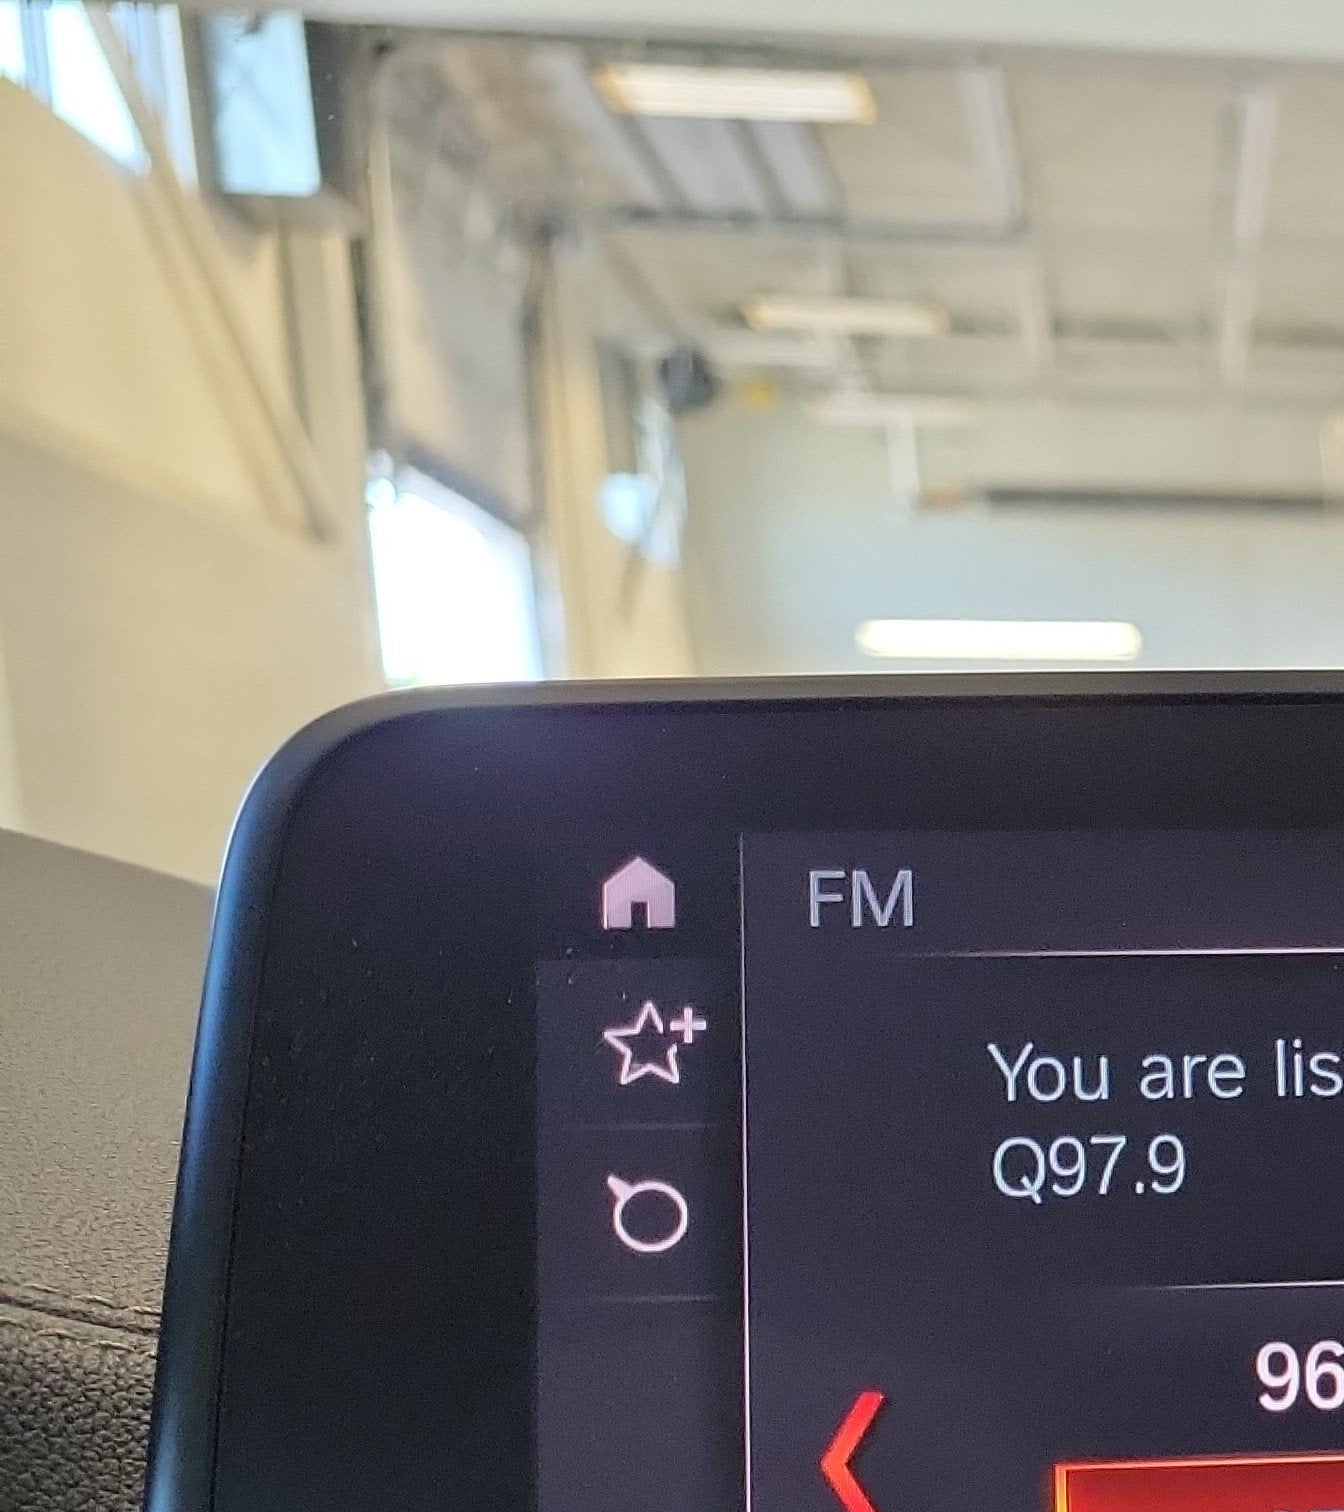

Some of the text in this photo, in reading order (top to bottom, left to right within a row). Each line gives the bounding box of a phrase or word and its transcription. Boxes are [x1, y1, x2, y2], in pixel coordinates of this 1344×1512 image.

[808, 868, 915, 929] FM
[986, 1041, 1110, 1103] You
[1139, 1052, 1247, 1101] are
[992, 1132, 1187, 1205] Q97.9
